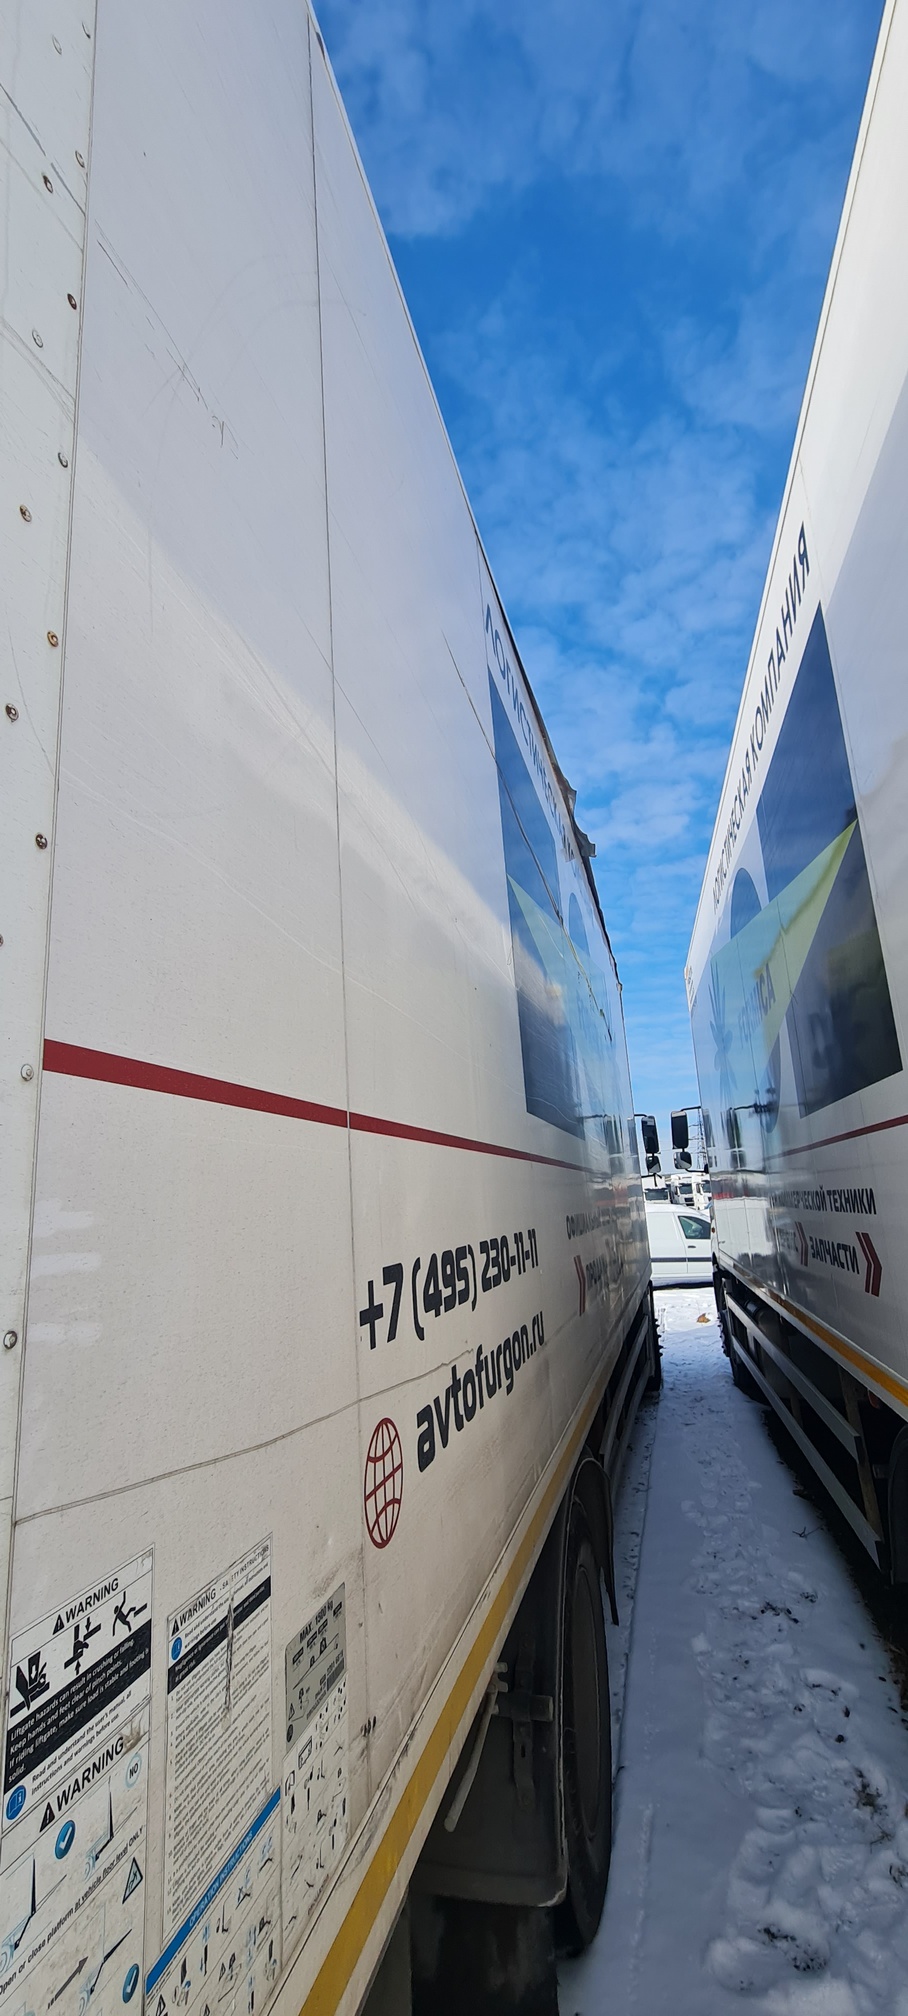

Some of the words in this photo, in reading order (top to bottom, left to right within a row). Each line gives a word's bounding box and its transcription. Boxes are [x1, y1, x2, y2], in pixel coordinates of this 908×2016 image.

[713, 748, 753, 915] ЛОГИСТИЧЕСКАЯ
[750, 521, 810, 771] КОМПАНИЯ
[827, 1187, 877, 1215] ТЕХНИКИ
[808, 1235, 860, 1275] ЗАПЧАСТИ
[359, 1263, 404, 1350] +7
[412, 1244, 478, 1341] (495)
[479, 1228, 539, 1293] 230-11-11
[416, 1311, 545, 1473] avtofurgon.ru
[65, 1578, 119, 1623] WARNING
[179, 1588, 216, 1627] WARNING
[222, 1570, 239, 1590] SAETY
[9, 1757, 16, 1769] If
[16, 1742, 34, 1762] riding
[35, 1725, 58, 1747] liftgate,
[59, 1711, 74, 1728] make
[75, 1701, 87, 1715] sure
[87, 1688, 99, 1705] load
[100, 1685, 104, 1693] is
[105, 1673, 119, 1689] stable
[120, 1663, 128, 1676] and
[129, 1651, 145, 1669] footing
[10, 1736, 27, 1755] Keep
[28, 1722, 46, 1740] hands
[47, 1710, 58, 1726] and
[59, 1703, 70, 1715] feet
[71, 1691, 84, 1708] clear
[85, 1682, 91, 1694] of
[92, 1672, 105, 1690] pinch
[11, 1717, 34, 1741] Liftgate
[36, 1699, 58, 1721] hazards
[59, 1689, 69, 1703] can
[70, 1677, 86, 1694] result
[86, 1671, 92, 1680] in
[92, 1656, 113, 1676] crushing
[113, 1651, 119, 1659] or
[8, 1763, 26, 1783] solid.
[32, 1766, 46, 1783] Read
[47, 1756, 57, 1771] and
[58, 1730, 86, 1760] understand
[86, 1724, 95, 1735] the
[57, 1737, 124, 1812] WARNING
[63, 1752, 73, 1767] and
[74, 1735, 95, 1757] warnings
[96, 1720, 110, 1737] before
[128, 1762, 139, 1779] NO
[18, 1960, 26, 1974] or
[28, 1938, 46, 1963] close
[47, 1908, 73, 1942] platform
[75, 1900, 81, 1912] at
[82, 1876, 101, 1903] vehicle
[102, 1862, 116, 1880] floor
[116, 1847, 128, 1866] level
[128, 1828, 143, 1847] ONLY
